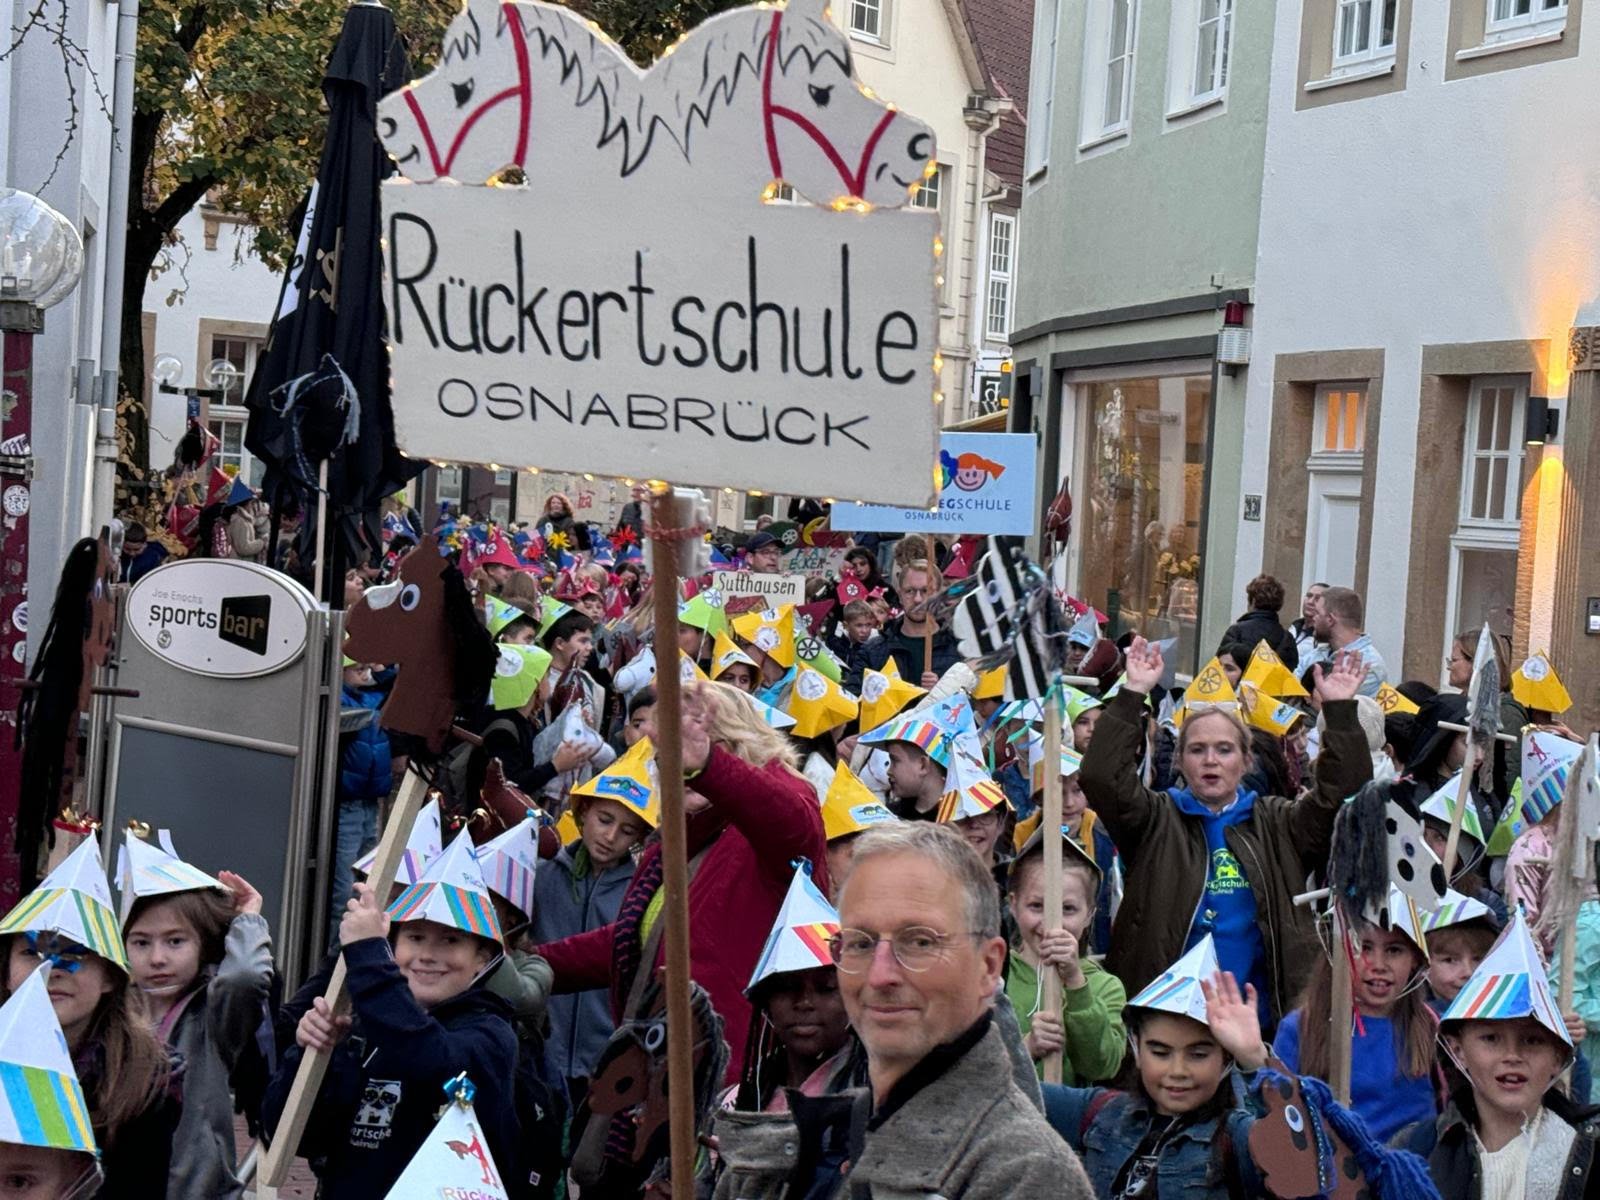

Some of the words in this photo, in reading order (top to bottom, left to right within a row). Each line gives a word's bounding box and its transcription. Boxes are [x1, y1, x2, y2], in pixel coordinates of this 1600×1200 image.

[389, 213, 919, 384] Rückertschule
[438, 378, 871, 450] OSNABRÜCK
[904, 511, 965, 522] OSNABRÜCK
[152, 588, 168, 599] Joe
[719, 572, 796, 596] Sutthausen
